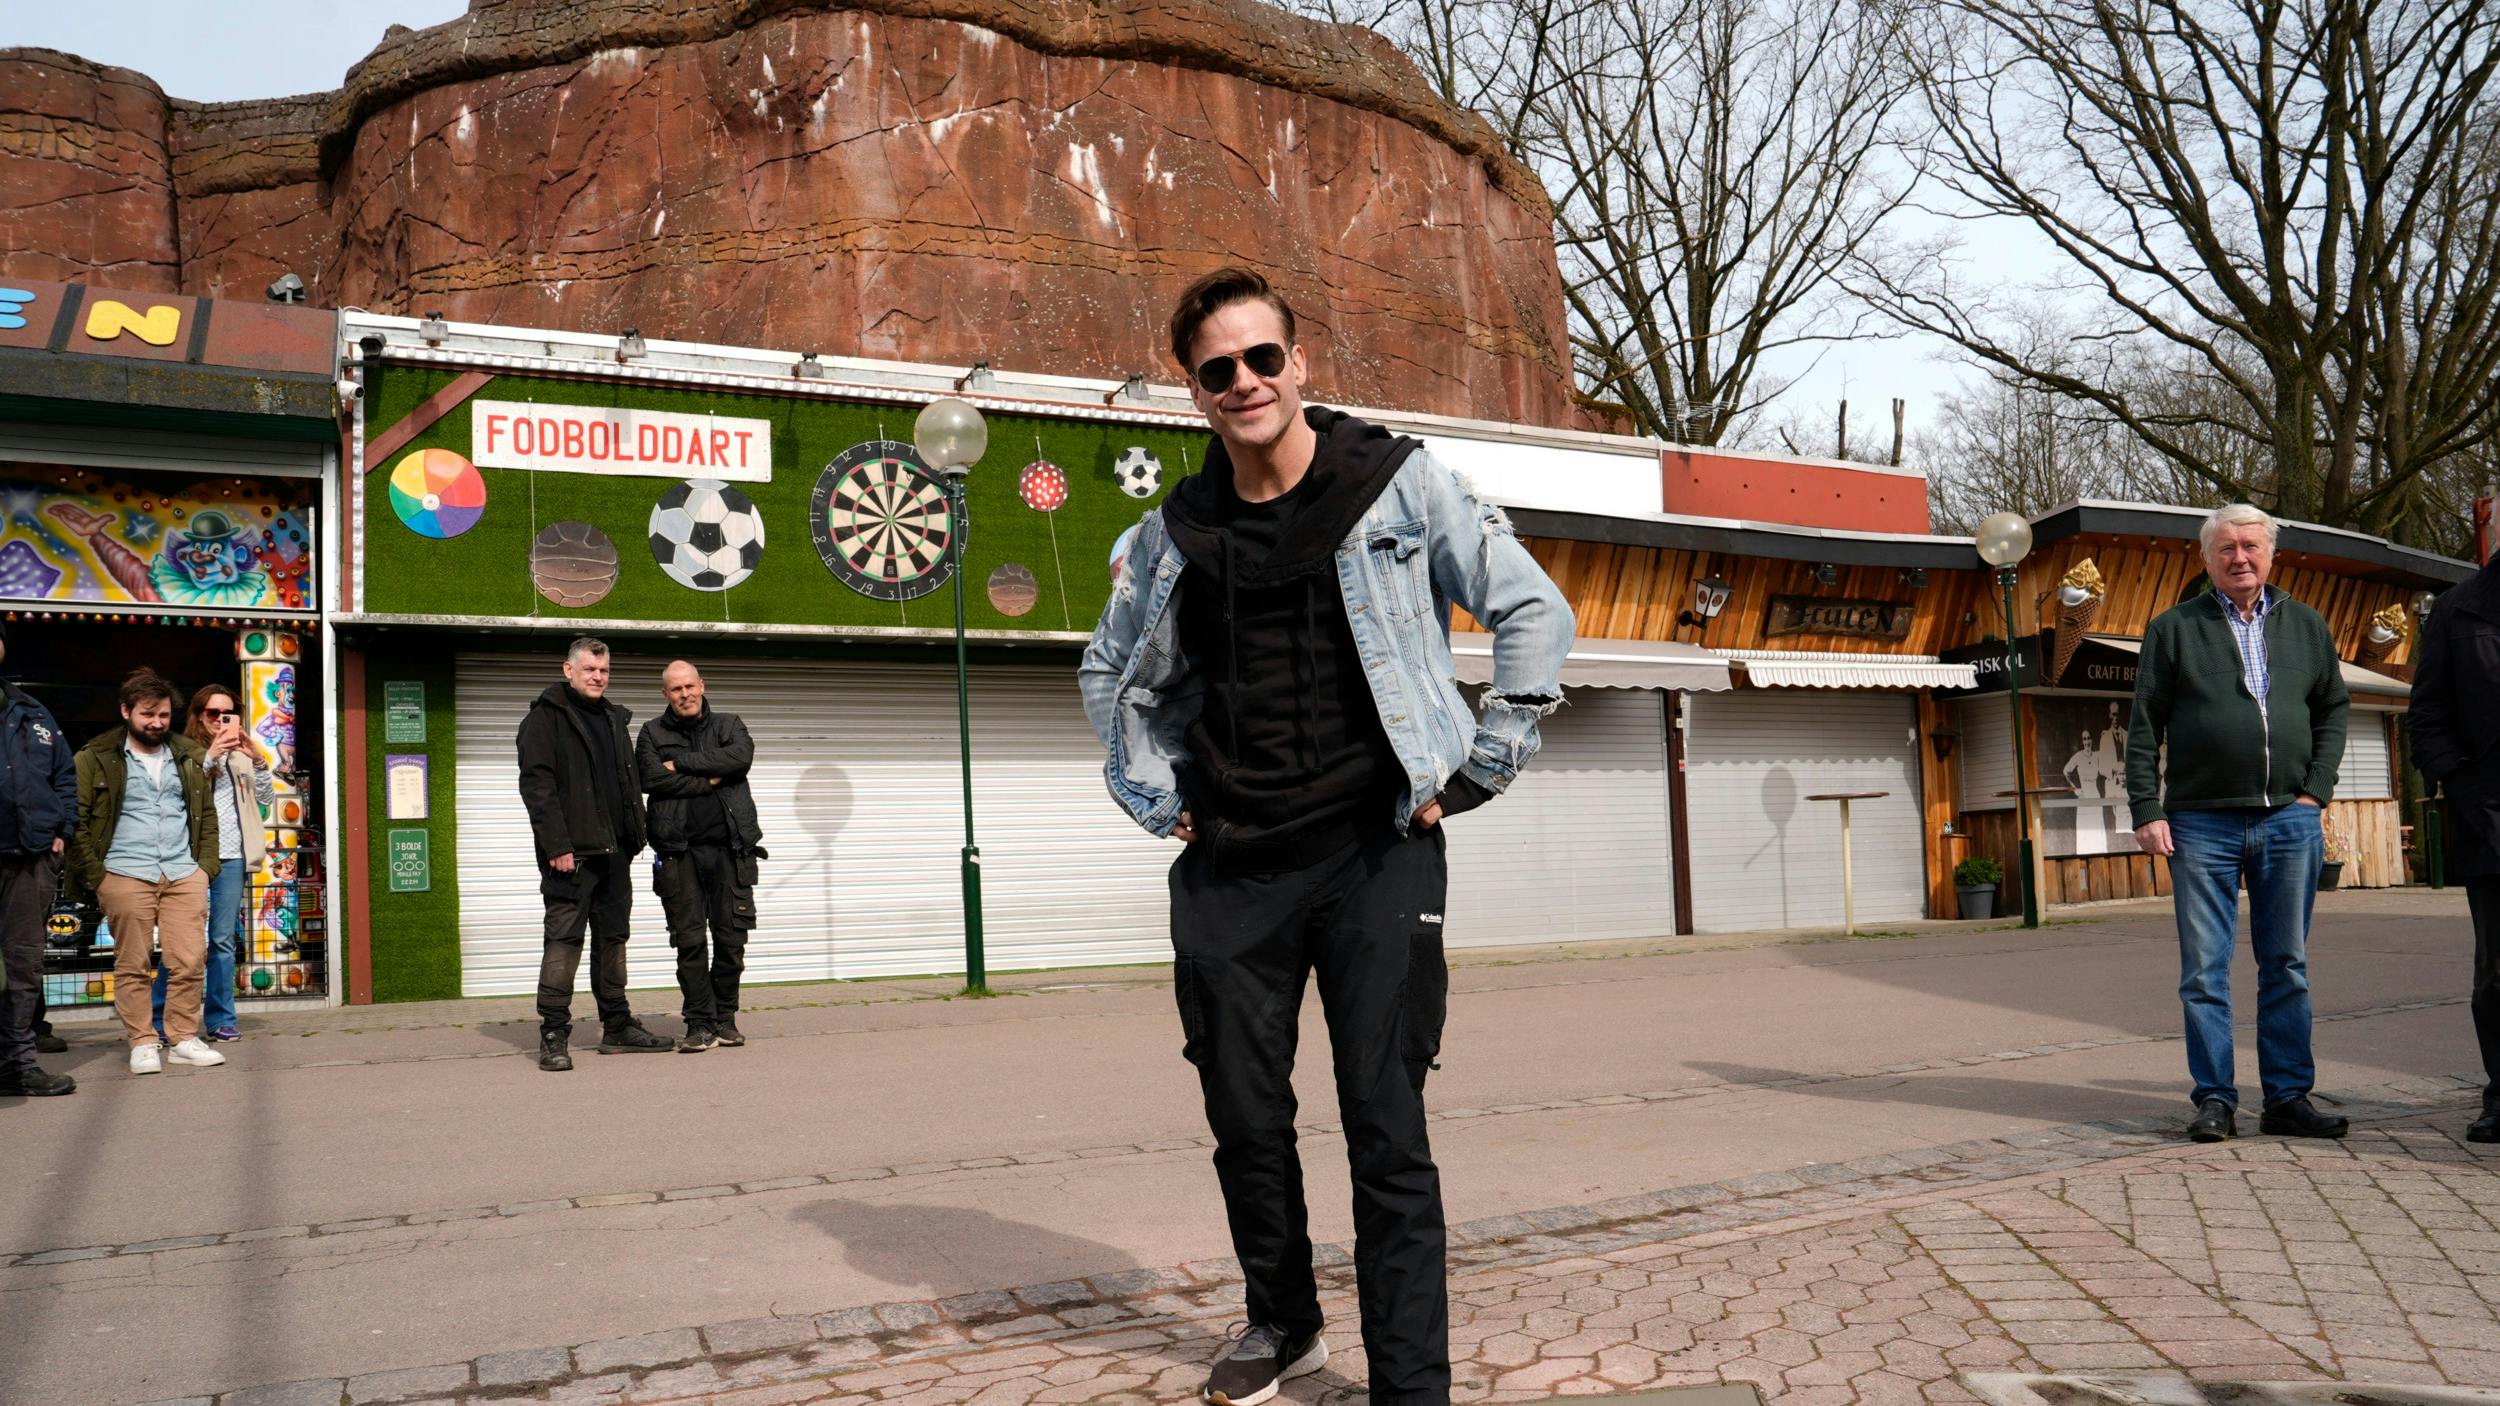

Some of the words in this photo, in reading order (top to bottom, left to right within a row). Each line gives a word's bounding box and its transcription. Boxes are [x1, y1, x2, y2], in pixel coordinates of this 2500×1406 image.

[487, 415, 752, 467] FODBOLDDART
[1967, 656, 2002, 675] GISK
[2087, 664, 2121, 681] CRAFT
[2123, 666, 2139, 682] BE
